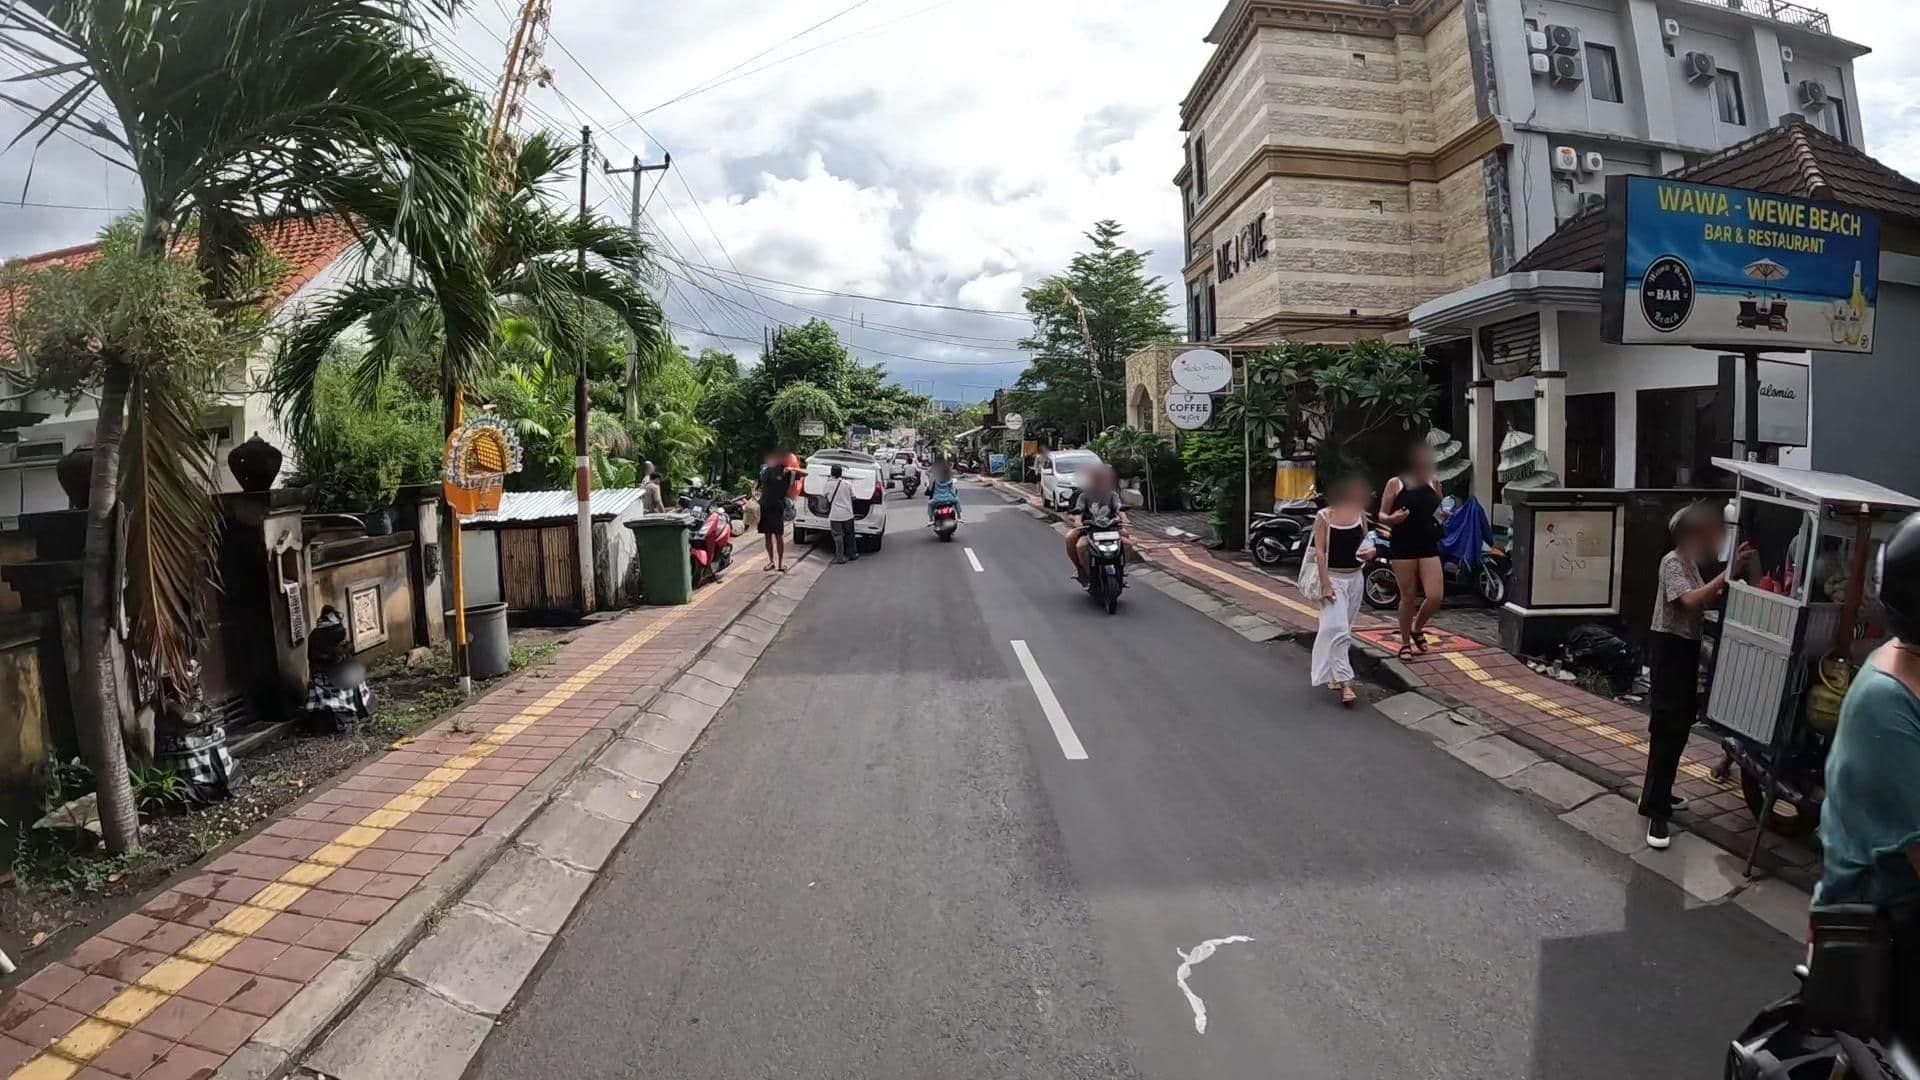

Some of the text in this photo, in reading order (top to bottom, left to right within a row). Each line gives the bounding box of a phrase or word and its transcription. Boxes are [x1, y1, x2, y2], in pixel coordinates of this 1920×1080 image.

[1658, 185, 1729, 216] WAWA
[1747, 197, 1805, 228] WEWE
[1809, 207, 1861, 237] BEACH
[1704, 223, 1825, 254] BAR & RESTAURANT
[1656, 289, 1681, 301] BAR
[1757, 380, 1797, 400] alomia
[1169, 403, 1209, 413] COFFEE
[1560, 552, 1586, 575] Spa
